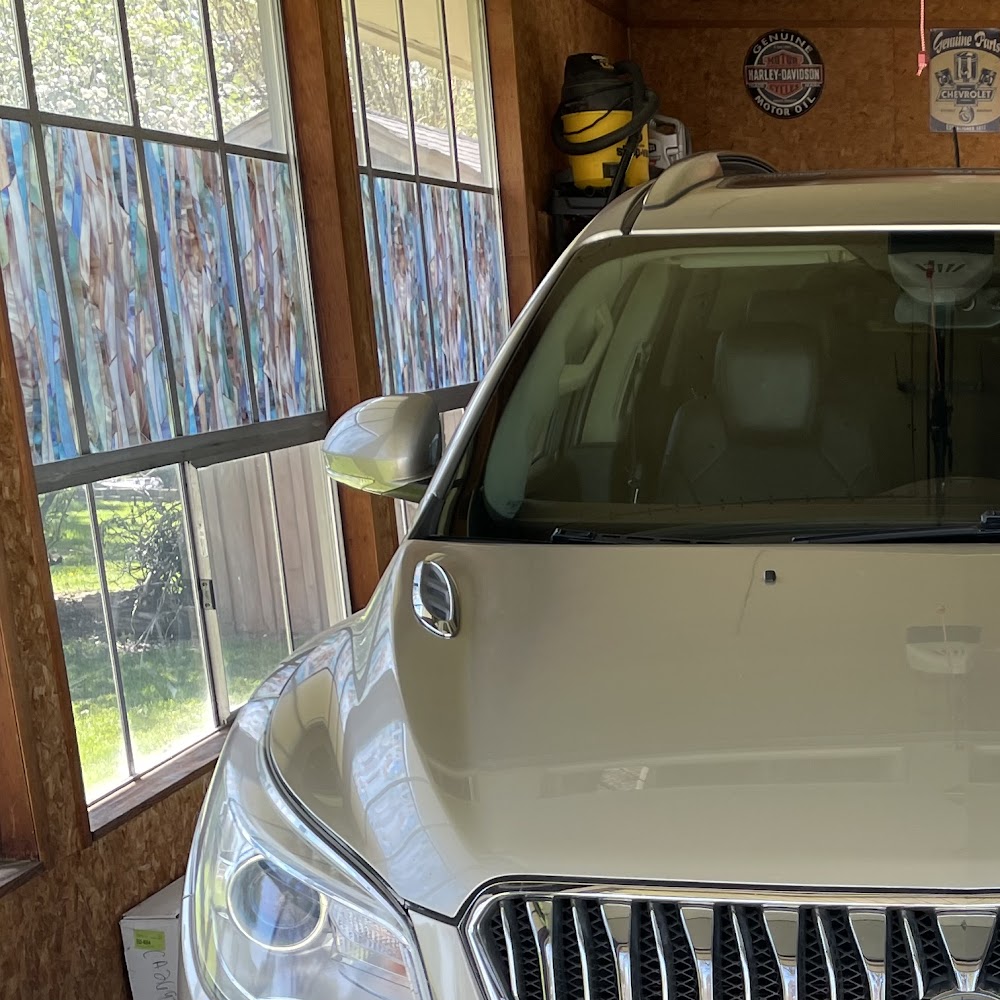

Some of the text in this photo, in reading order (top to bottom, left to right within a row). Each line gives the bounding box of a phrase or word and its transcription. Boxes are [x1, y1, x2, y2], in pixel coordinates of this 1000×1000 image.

[752, 32, 814, 54] GENUINE
[932, 31, 1000, 54] Genuine Parts
[748, 68, 820, 81] HARLEY-DAVIDSON
[941, 89, 992, 99] CHEVROLET
[754, 95, 816, 116] MOTOR OIL
